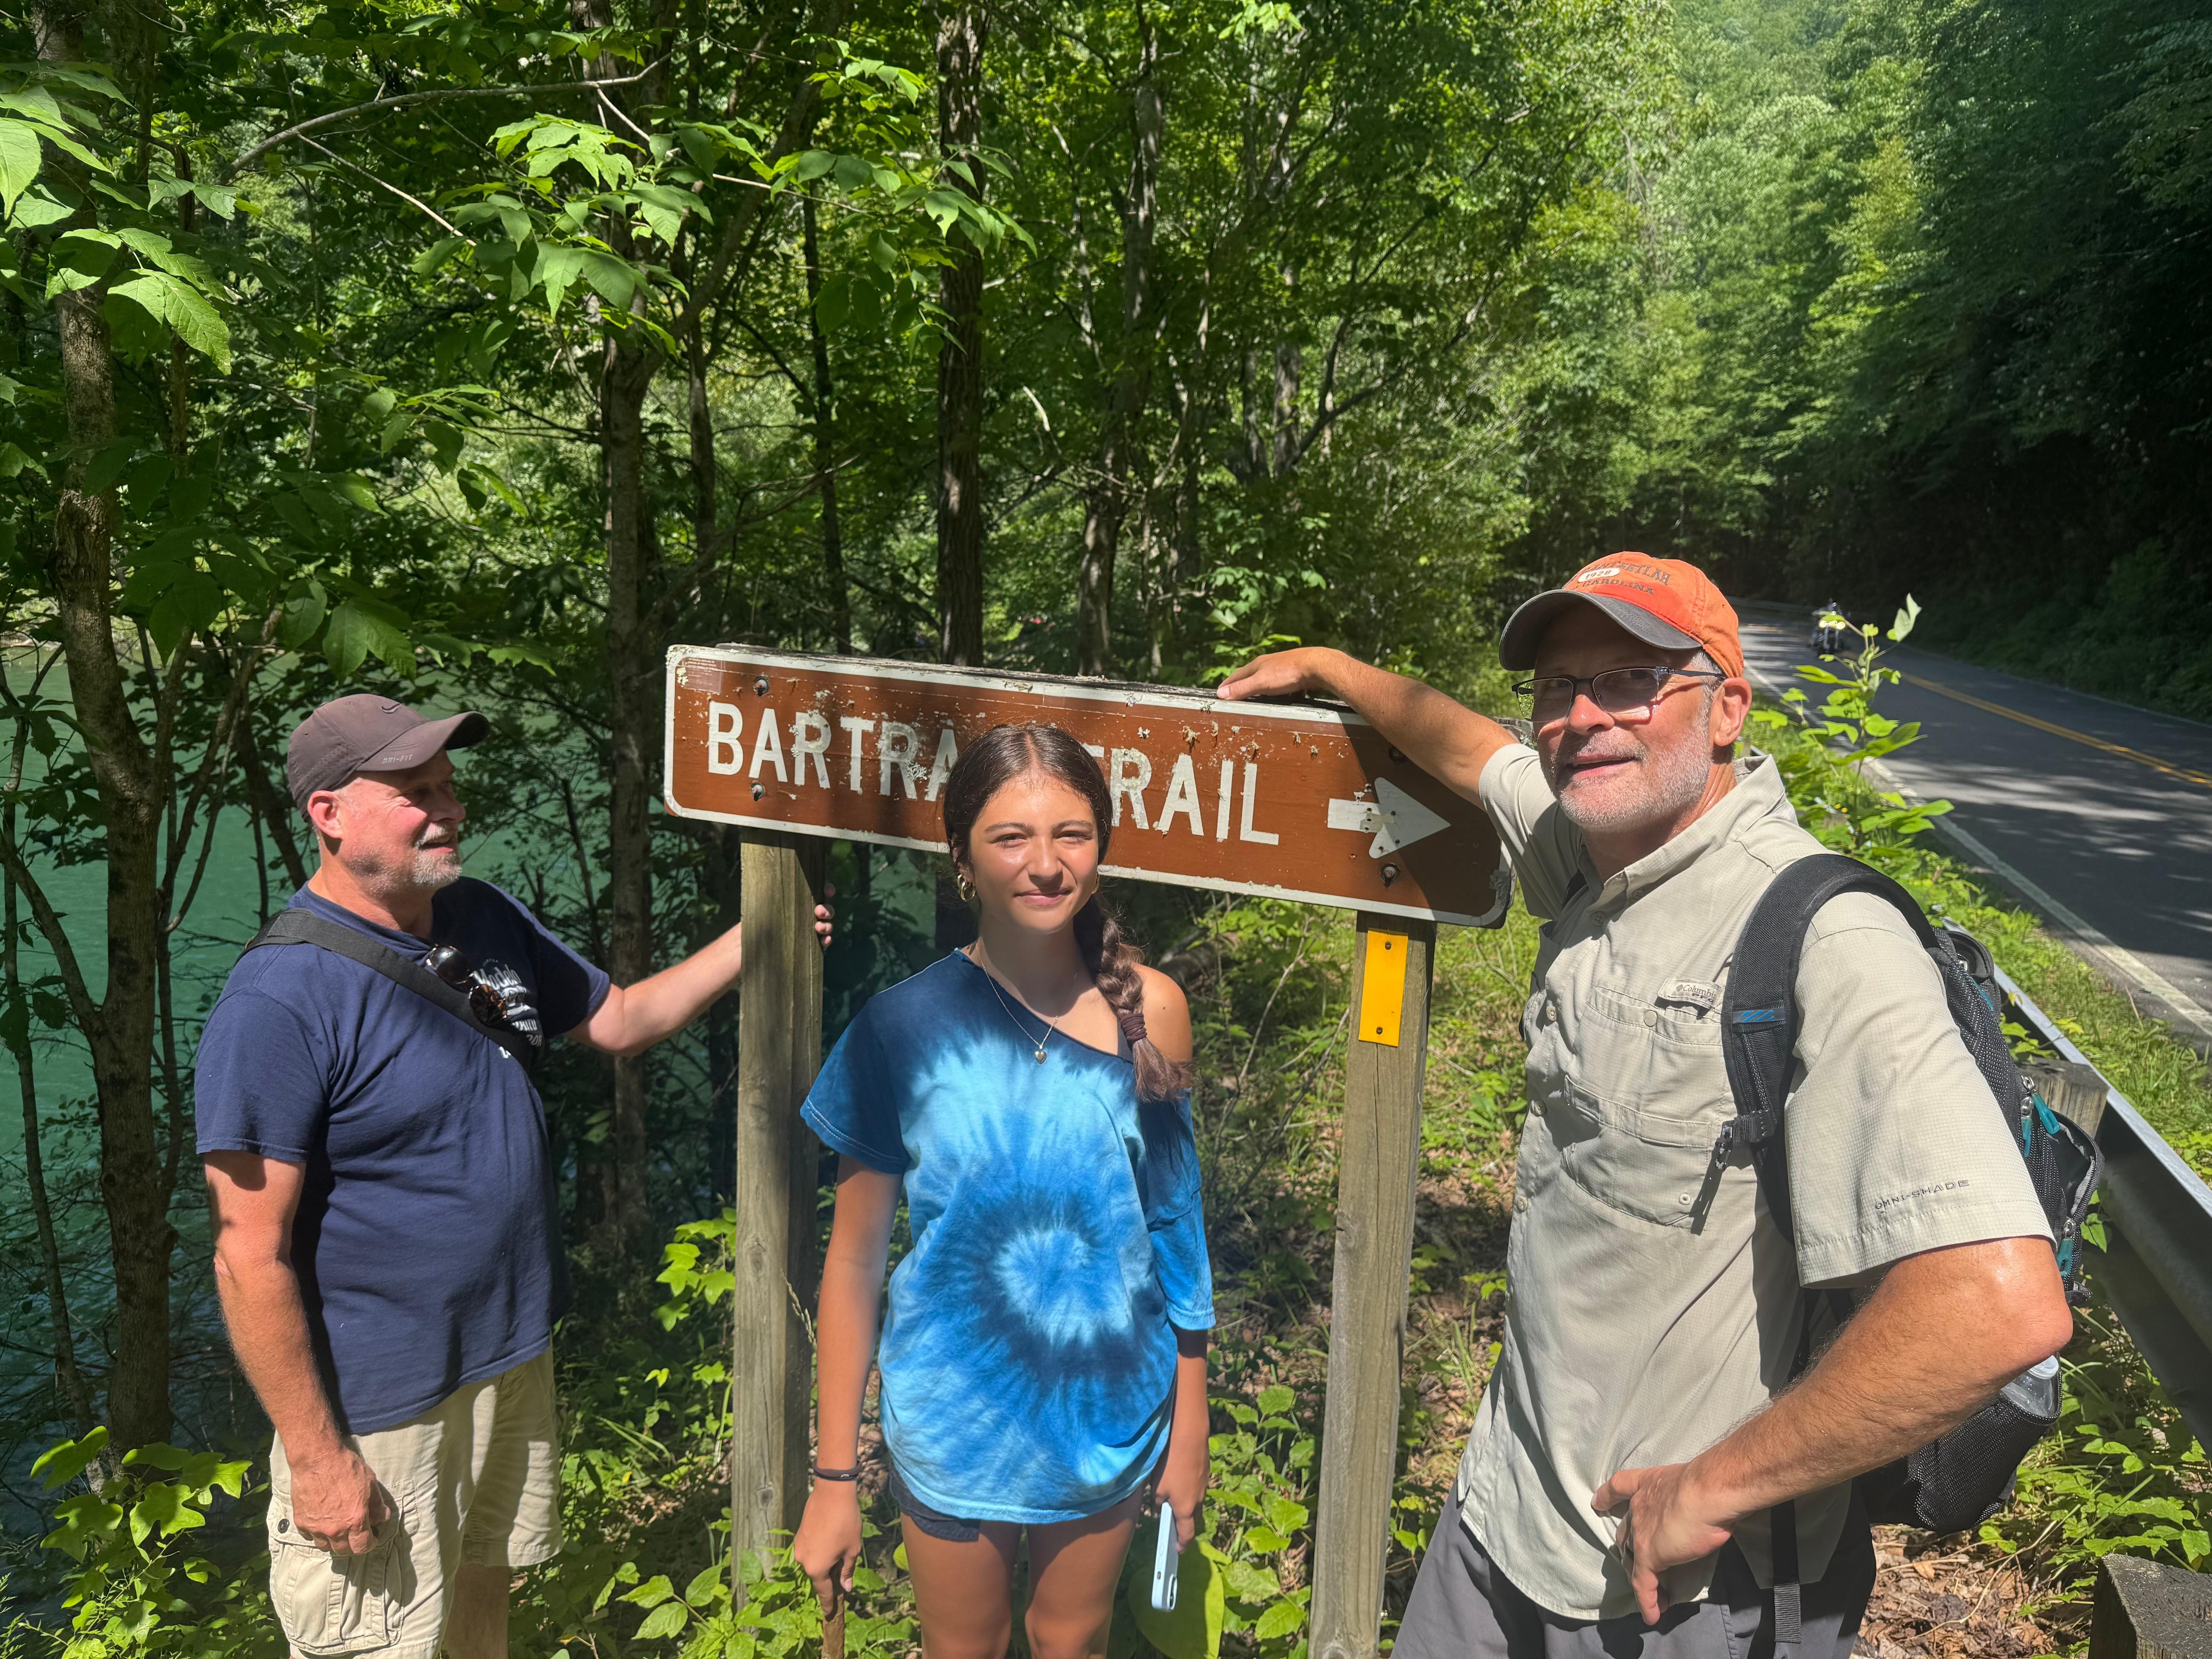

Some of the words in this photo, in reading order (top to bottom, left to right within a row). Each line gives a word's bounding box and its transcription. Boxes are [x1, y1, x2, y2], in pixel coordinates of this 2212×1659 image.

[1585, 570, 1612, 580] 1928
[1582, 579, 1655, 595] CAROLINA
[381, 754, 413, 764] DRI-FIT
[708, 701, 960, 802] BARTRA
[1081, 742, 1279, 845] RAIL
[473, 964, 522, 991] Modelo
[1875, 1179, 1970, 1209] OMNI-SHADE
